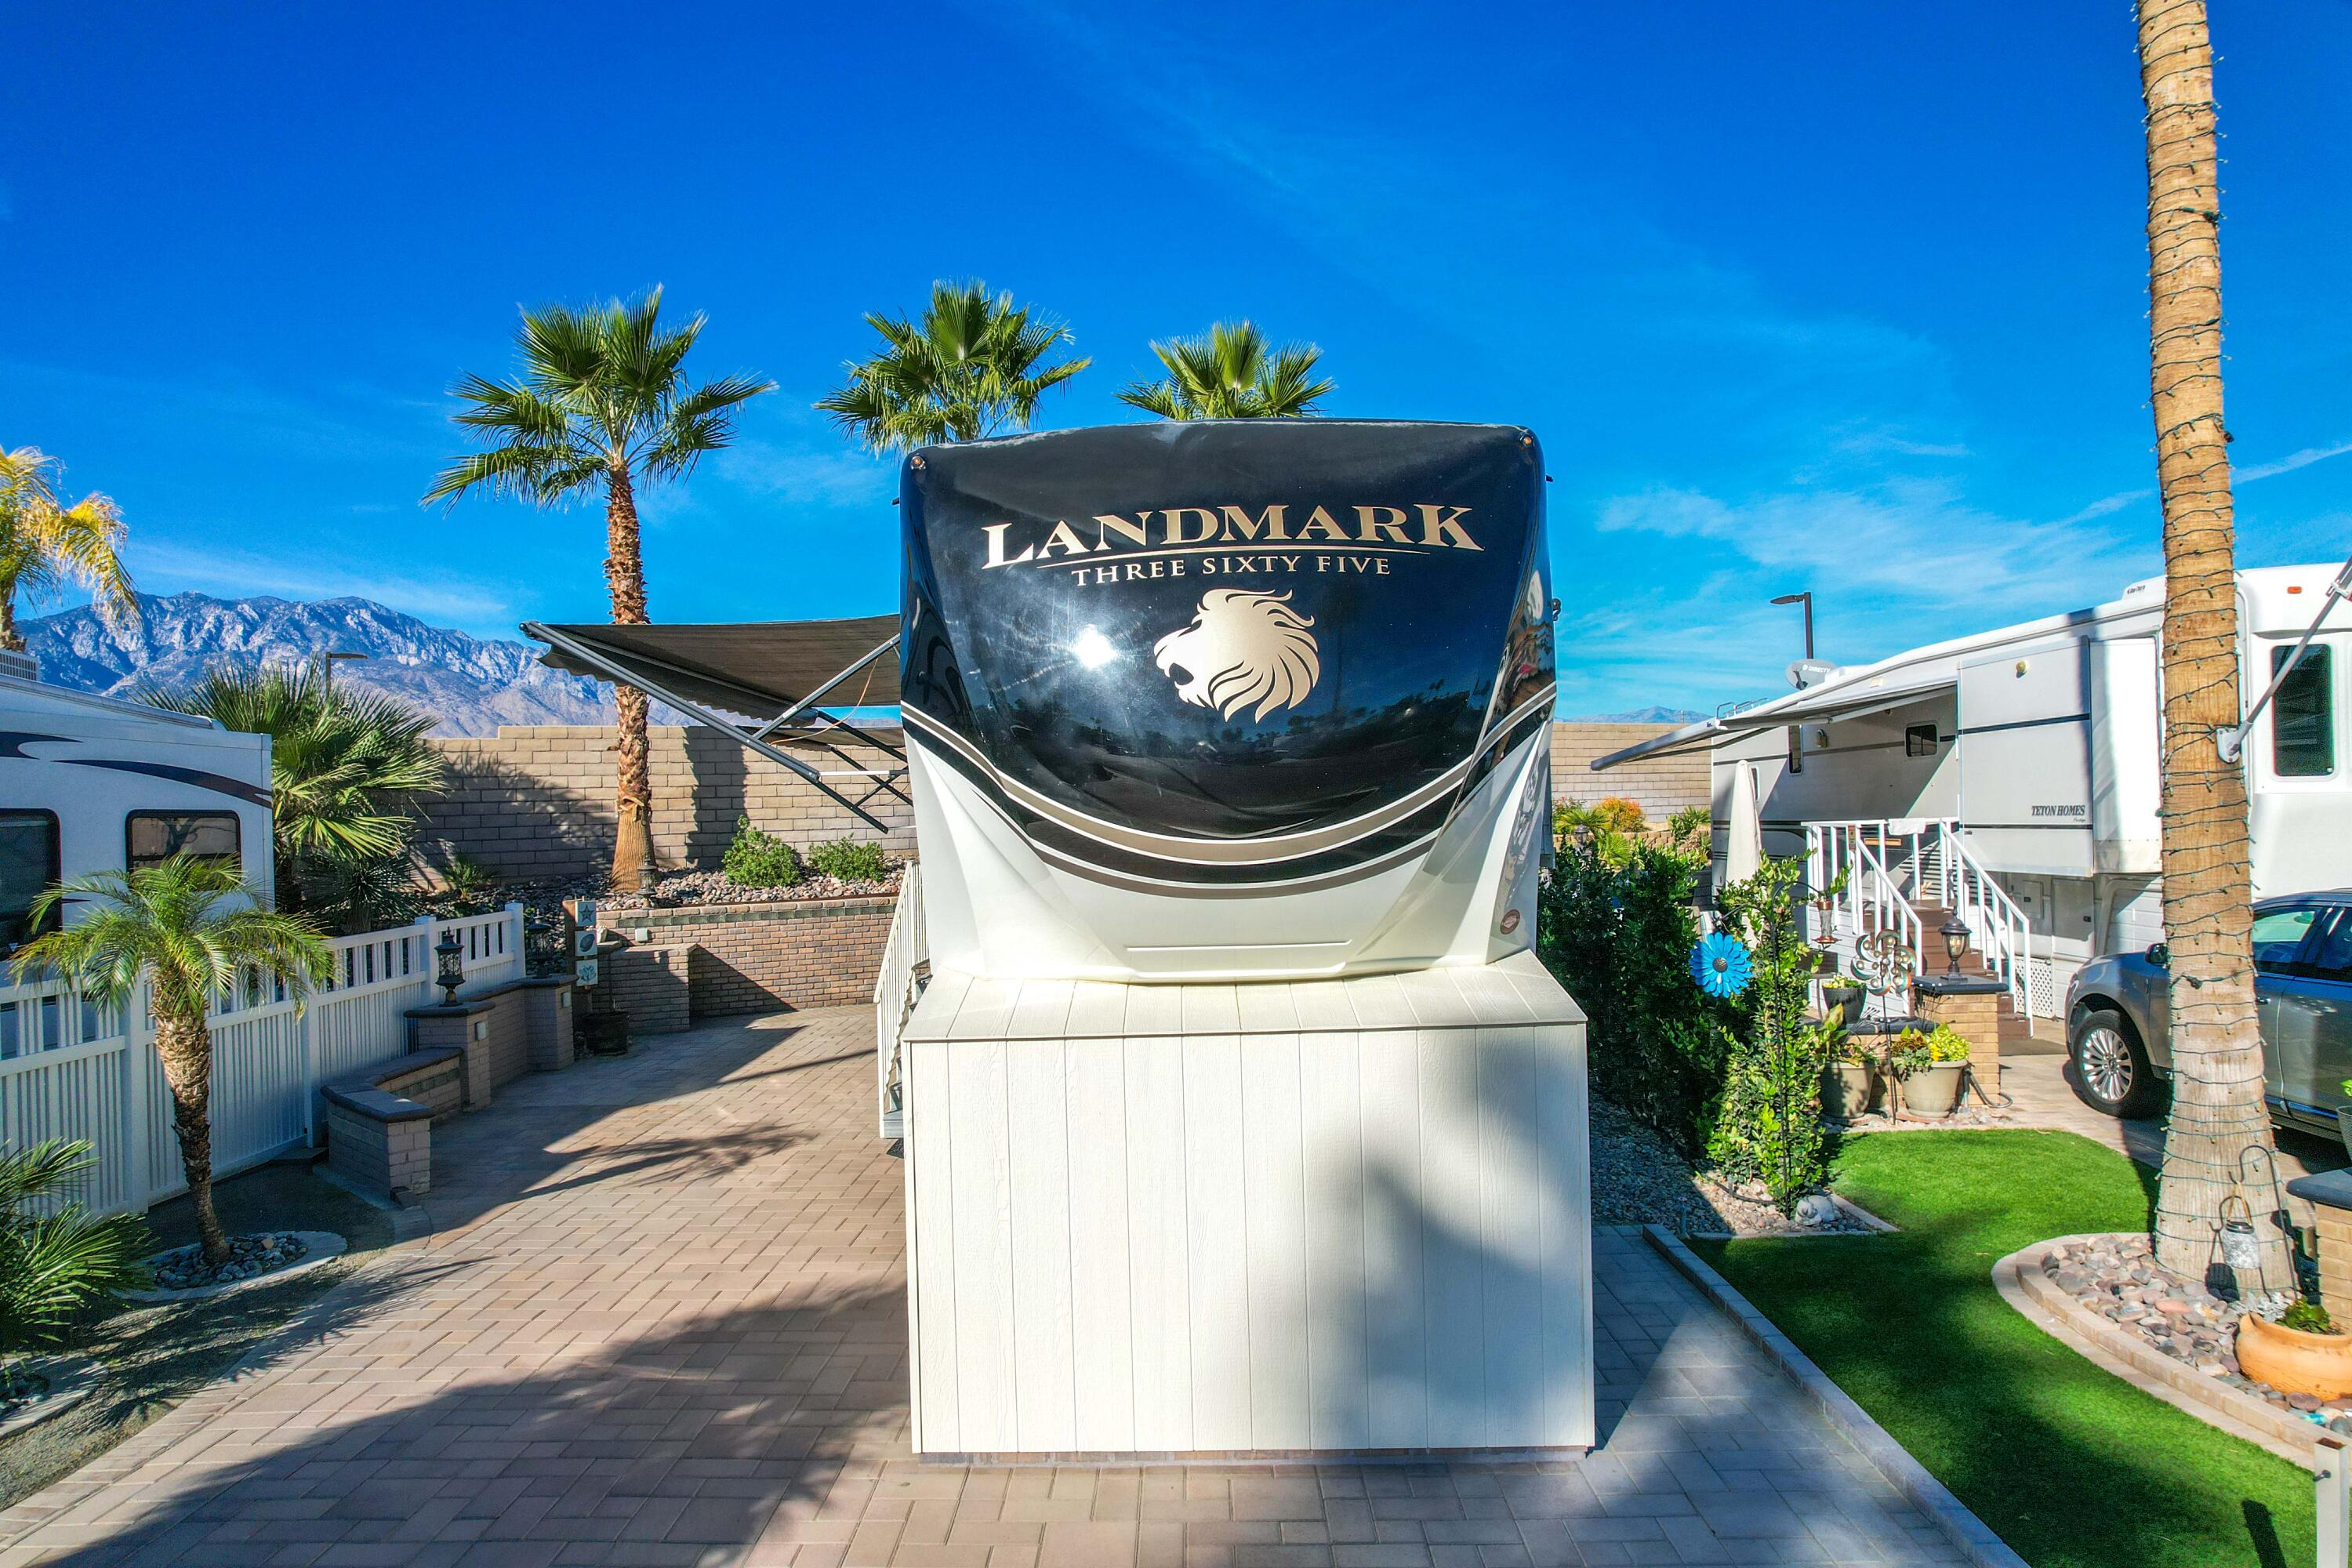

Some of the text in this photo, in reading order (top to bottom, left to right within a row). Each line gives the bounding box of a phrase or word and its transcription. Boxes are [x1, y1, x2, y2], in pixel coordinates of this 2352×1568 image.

[981, 504, 1484, 569] LANDMARK
[1072, 555, 1391, 586] THREE SIXTY FIVE
[2031, 804, 2085, 816] TETON HOMES
